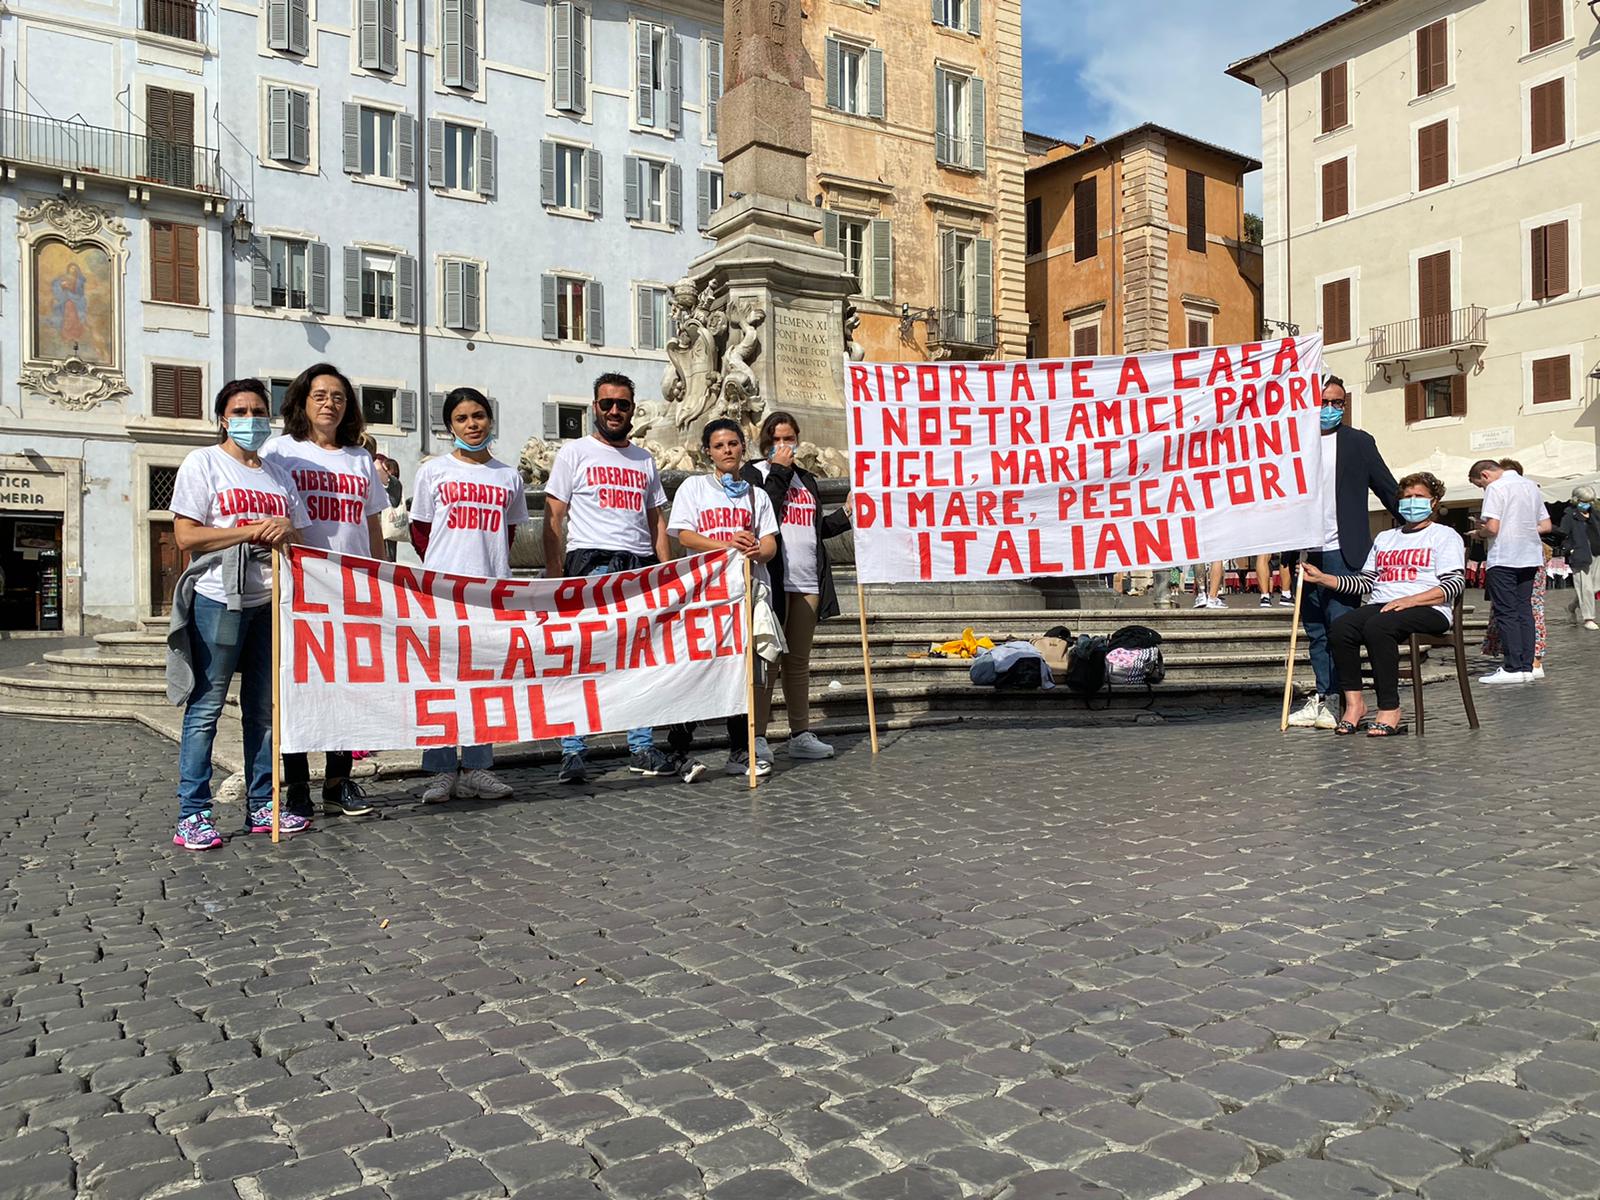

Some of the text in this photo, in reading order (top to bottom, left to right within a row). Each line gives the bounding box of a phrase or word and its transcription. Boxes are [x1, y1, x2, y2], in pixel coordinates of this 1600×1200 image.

[849, 338, 1299, 402] RIPORTATE A CASA
[853, 373, 1321, 446] I NOSTRI AMICI, PADRI
[855, 417, 1300, 487] FIGLI, MARITI, UOMINI
[0, 492, 44, 504] MERIA
[307, 495, 364, 525] SUBITO
[447, 506, 501, 533] SUBITO
[599, 488, 642, 512] SUBITO
[854, 492, 893, 529] DI
[907, 490, 1037, 528] MARE,
[1057, 457, 1307, 521] PESCATORI
[917, 516, 1200, 580] ITALIANI
[415, 679, 603, 746] SOLI
